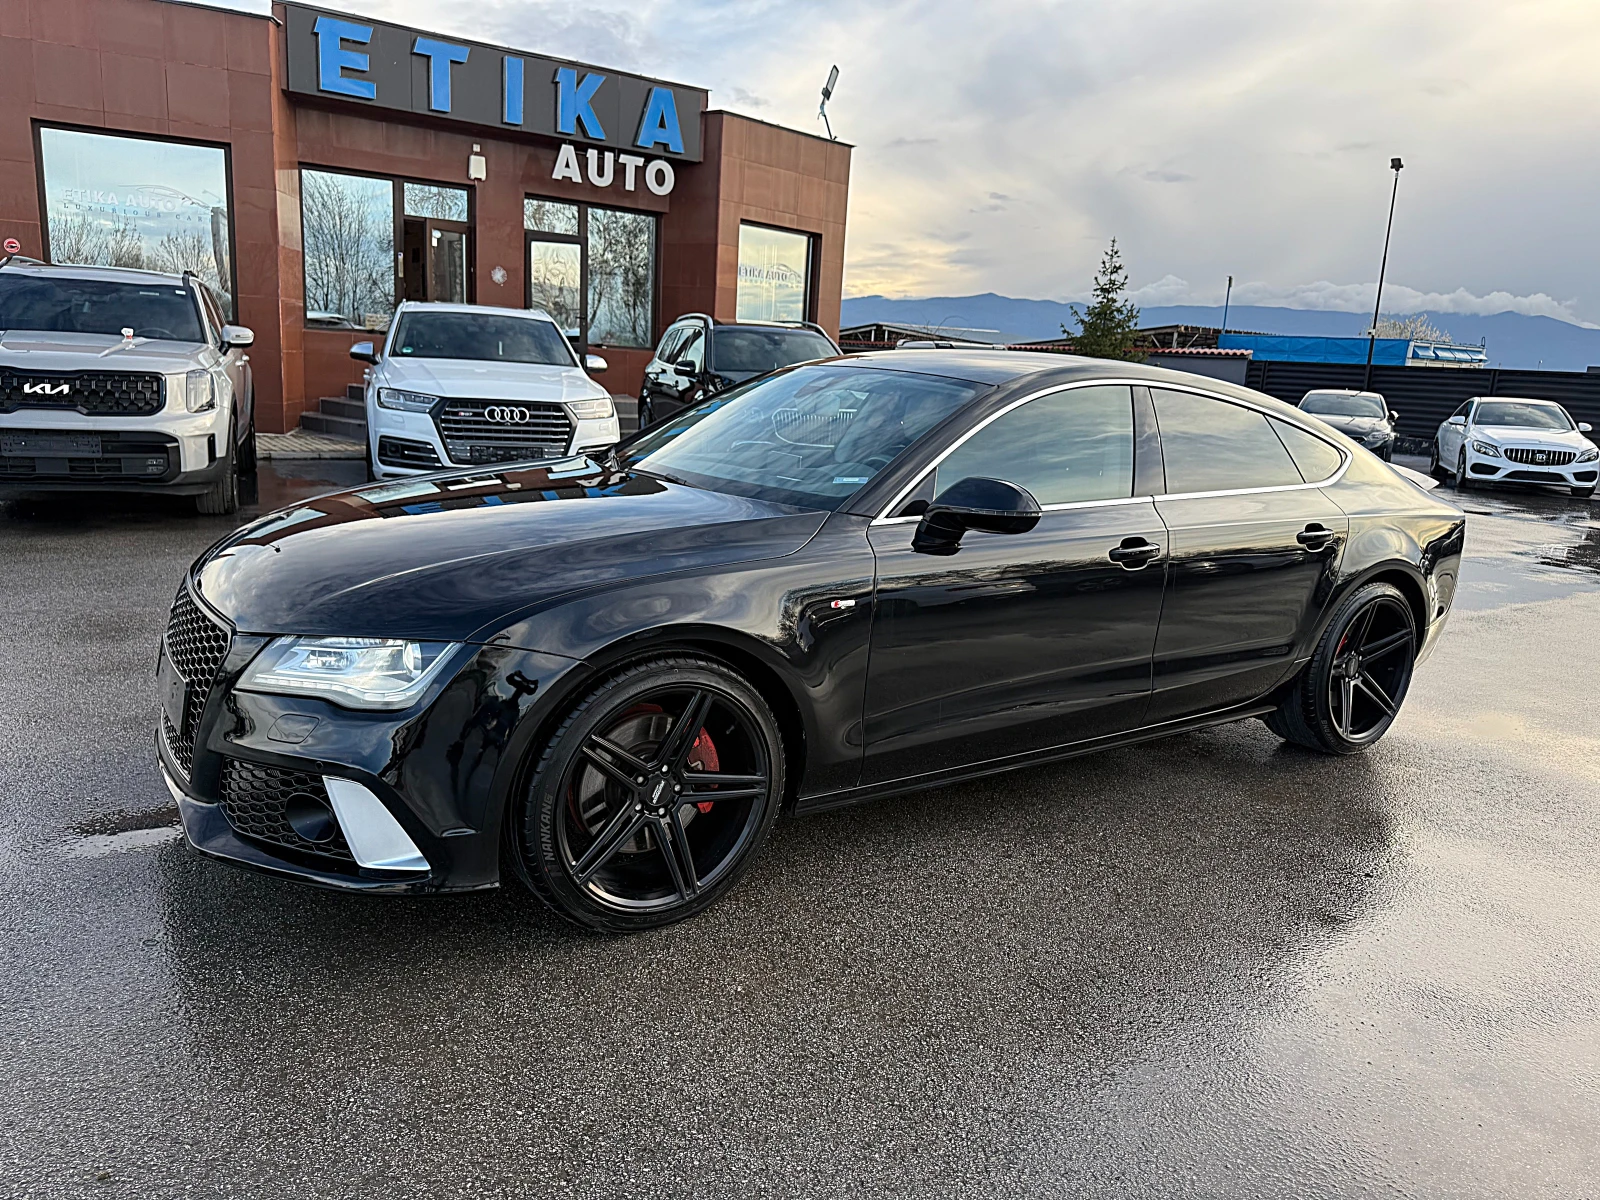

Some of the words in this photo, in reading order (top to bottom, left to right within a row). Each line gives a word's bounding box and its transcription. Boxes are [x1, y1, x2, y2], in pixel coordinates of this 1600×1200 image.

[313, 16, 685, 154] ETIKA
[551, 143, 675, 197] AUTO
[62, 187, 119, 206] ETIKA
[125, 194, 177, 212] AUTO
[24, 382, 70, 395] KIA
